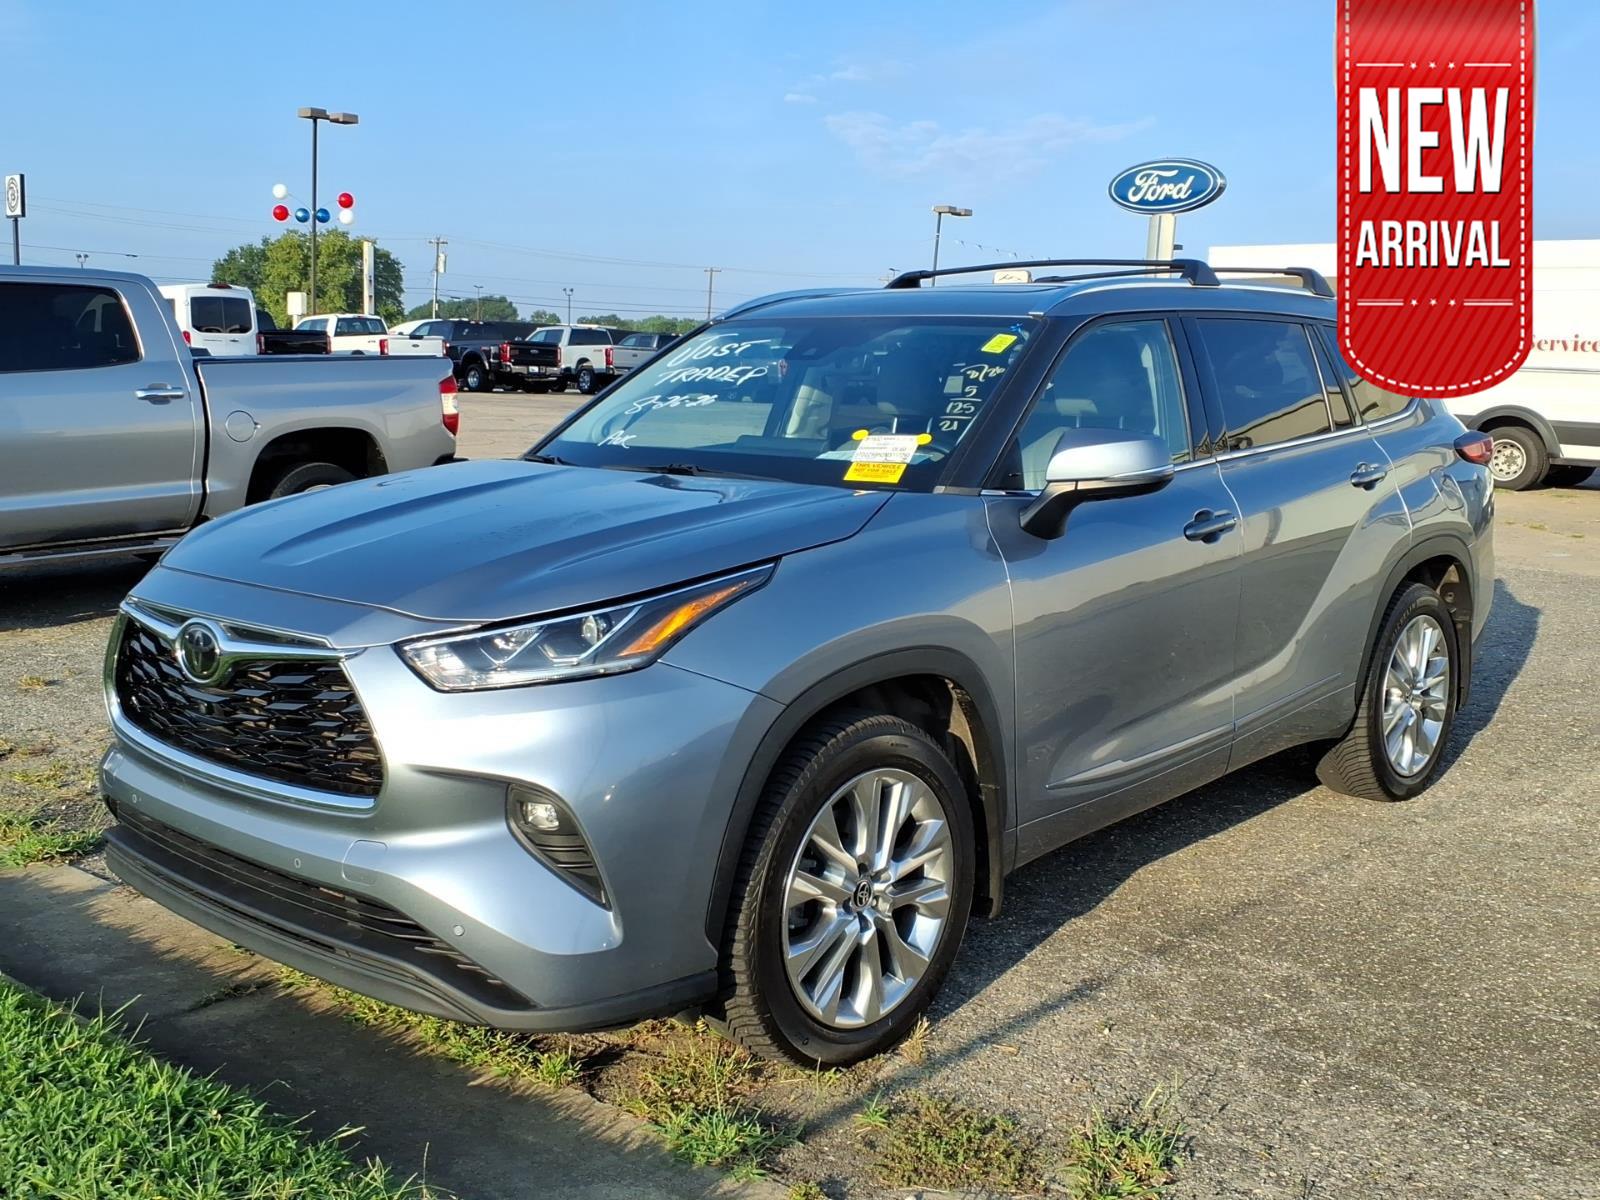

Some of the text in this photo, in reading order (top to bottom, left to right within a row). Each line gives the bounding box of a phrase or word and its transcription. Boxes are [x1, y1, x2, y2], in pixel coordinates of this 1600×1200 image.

[1128, 170, 1195, 202] Ford
[667, 333, 772, 367] JUST
[1532, 334, 1600, 352] ervice
